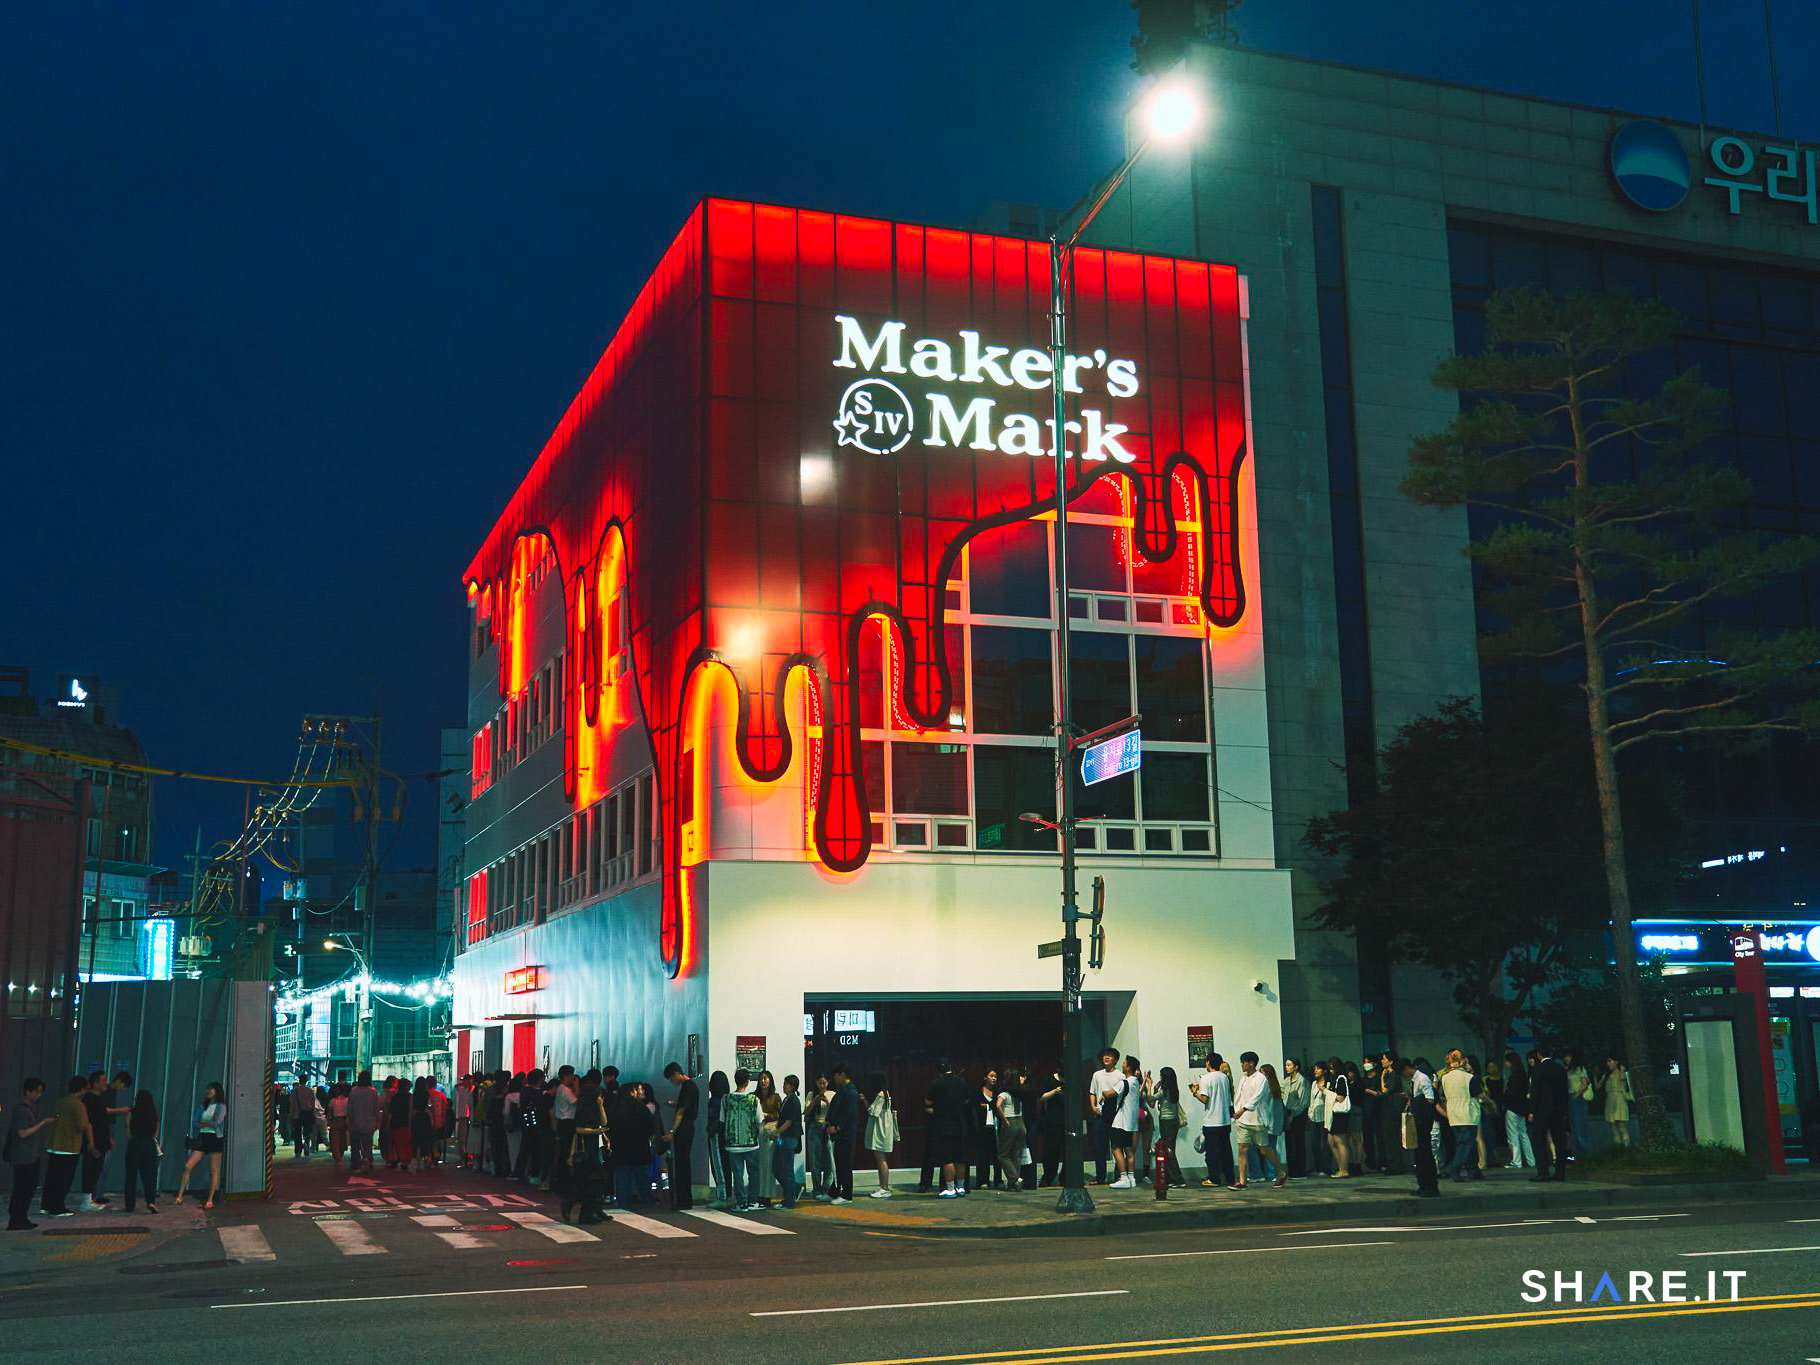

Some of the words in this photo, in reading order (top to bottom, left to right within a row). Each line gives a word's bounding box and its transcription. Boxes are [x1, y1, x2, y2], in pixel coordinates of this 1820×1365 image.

[1704, 136, 1818, 224] 우리
[832, 315, 1139, 398] Maker's
[922, 393, 1137, 463] Mark
[278, 1193, 542, 1215] 진입금지
